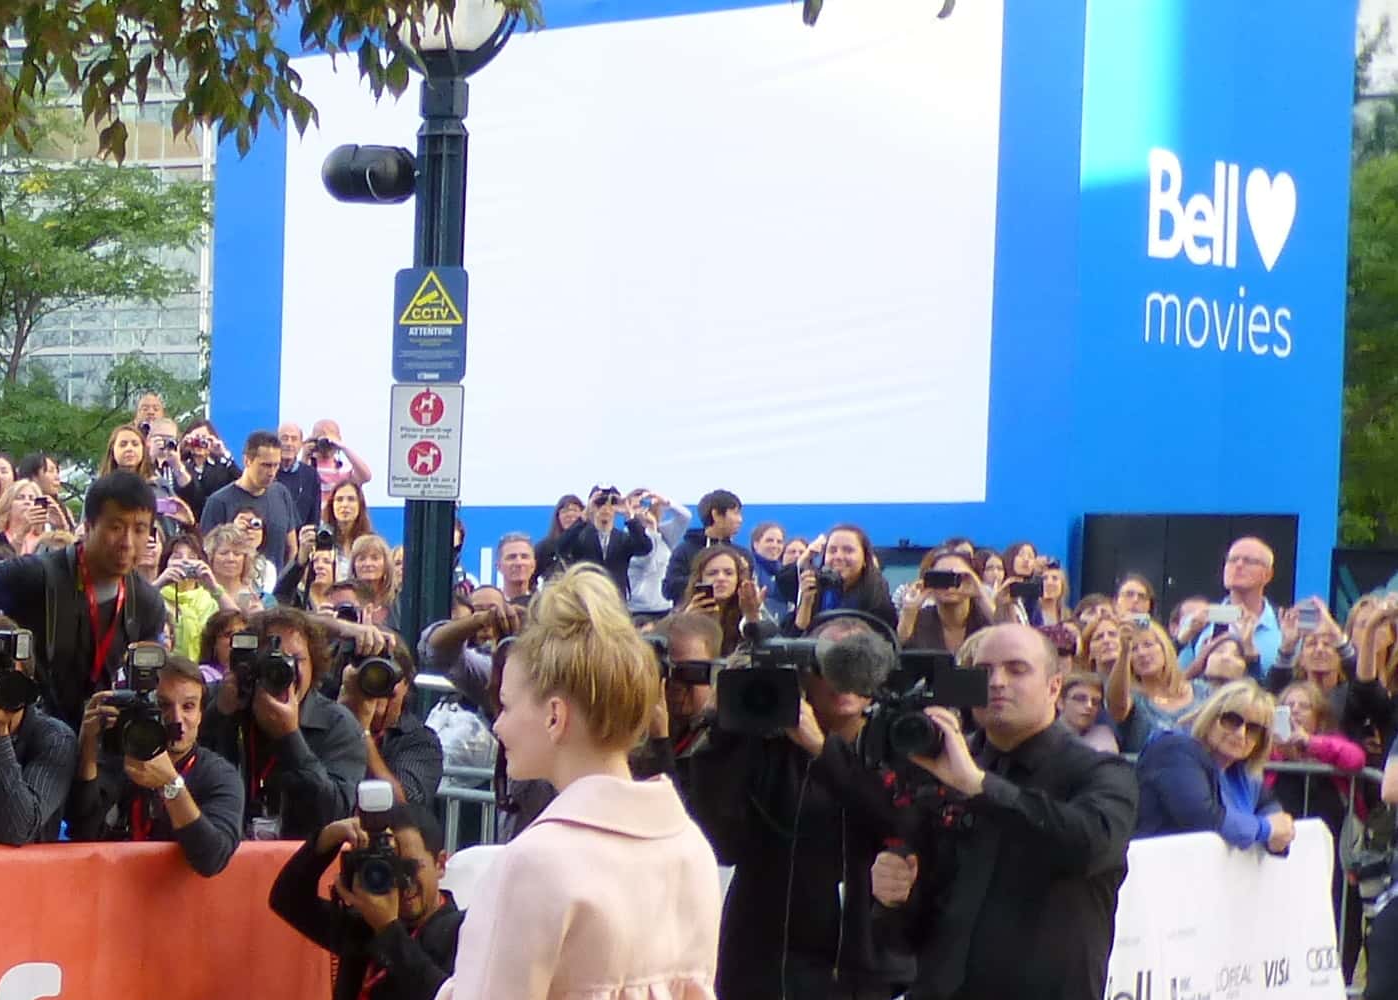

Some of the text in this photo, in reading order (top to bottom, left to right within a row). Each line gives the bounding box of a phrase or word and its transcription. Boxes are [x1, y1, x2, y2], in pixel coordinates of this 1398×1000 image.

[1147, 146, 1239, 269] Bell
[408, 326, 453, 337] ATTENTION
[411, 307, 449, 320] CCTV
[1144, 285, 1292, 358] movies
